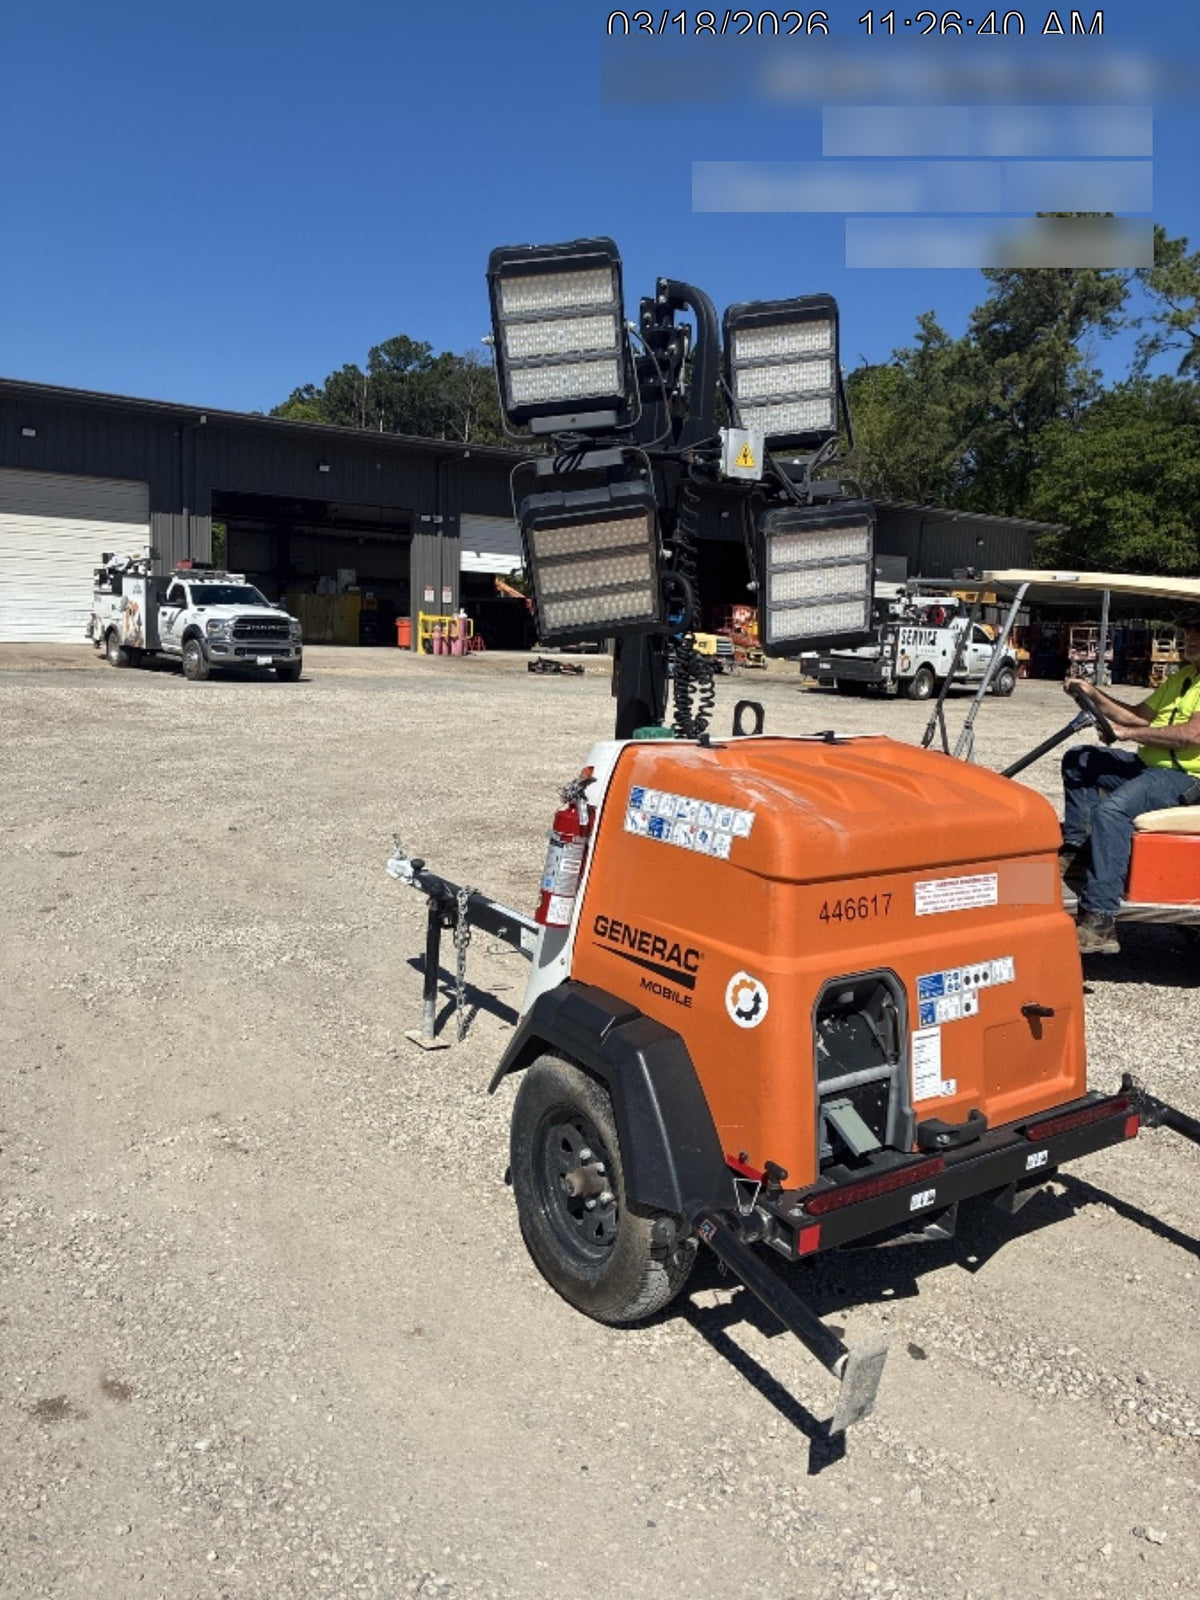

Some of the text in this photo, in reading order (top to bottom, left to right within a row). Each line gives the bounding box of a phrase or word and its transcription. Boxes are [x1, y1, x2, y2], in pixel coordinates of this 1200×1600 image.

[901, 629, 938, 646] SERVICE
[819, 893, 892, 924] 446617
[592, 915, 701, 973] GENERAC
[640, 977, 693, 1008] MOBILE
